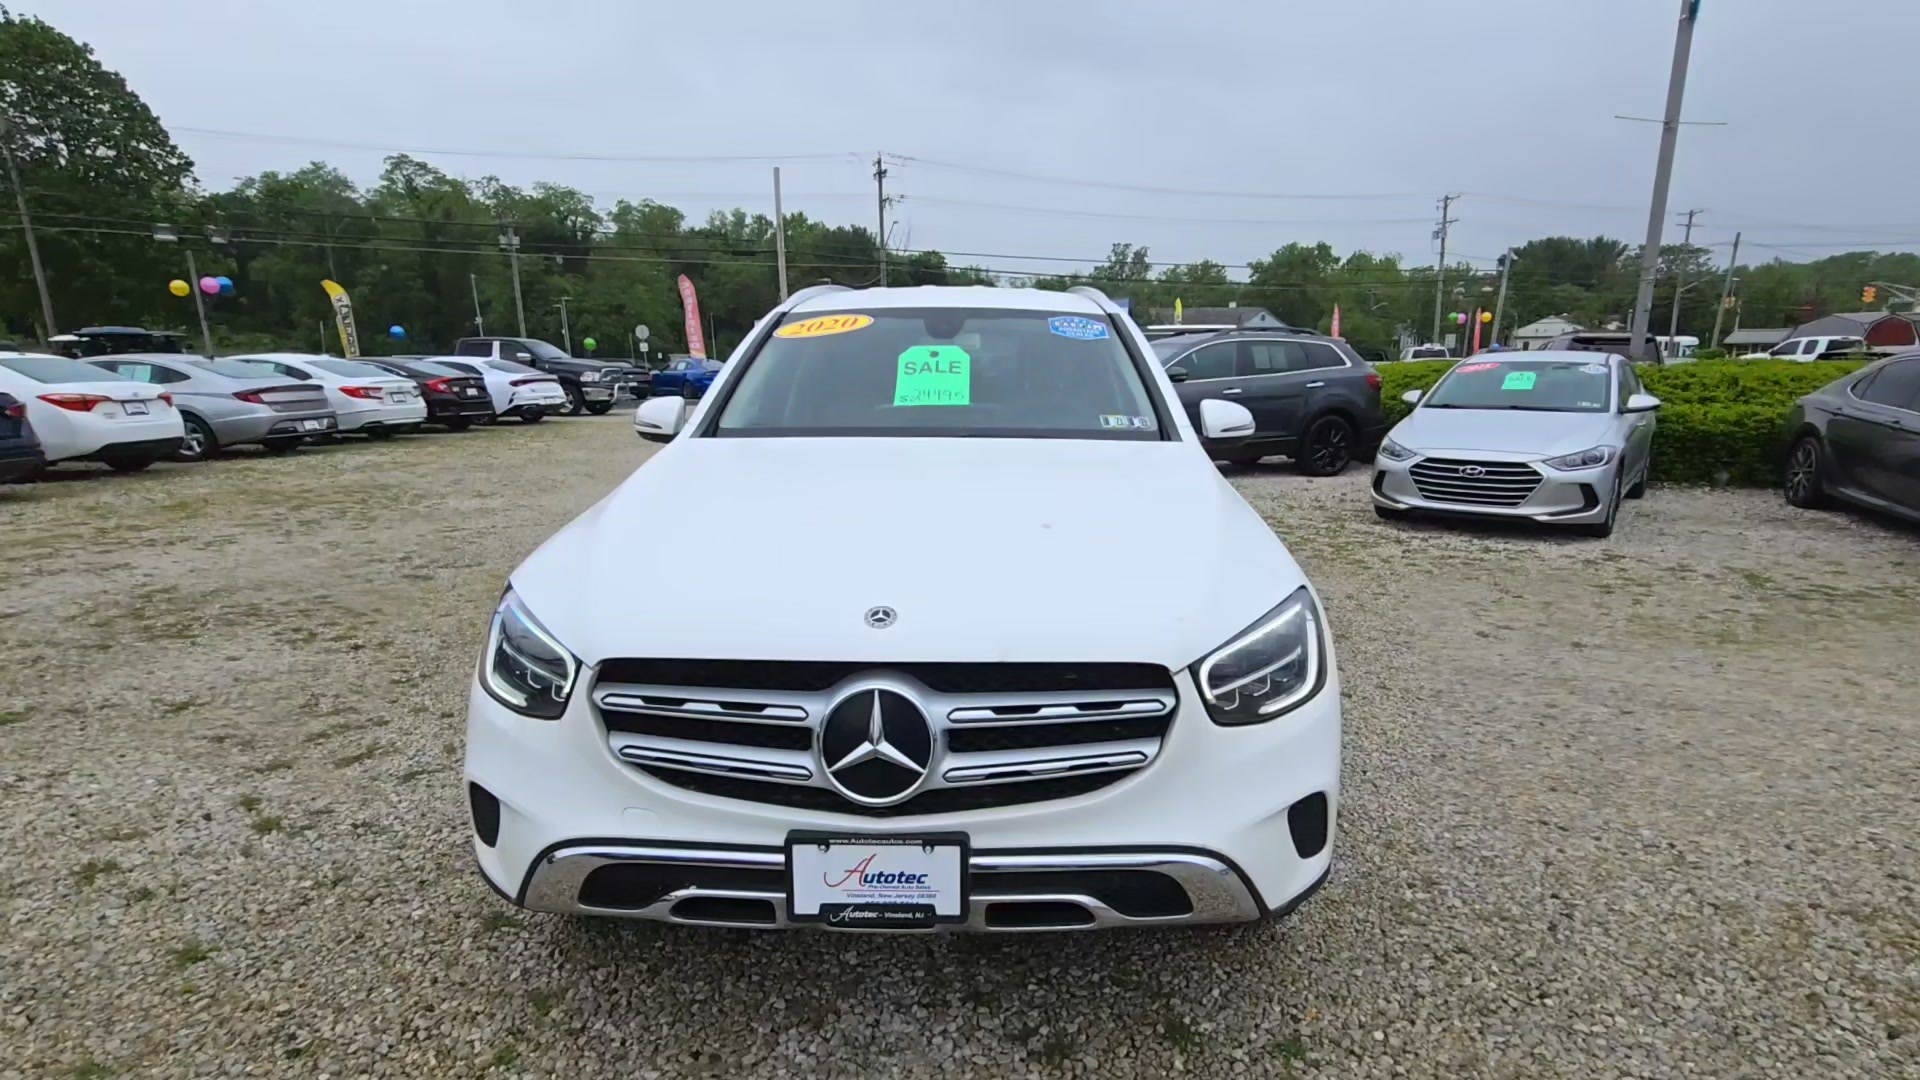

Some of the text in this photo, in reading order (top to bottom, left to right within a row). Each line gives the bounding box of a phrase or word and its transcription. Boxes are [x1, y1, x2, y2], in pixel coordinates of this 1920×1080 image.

[789, 316, 859, 335] 2020
[904, 360, 962, 375] SALE
[823, 853, 929, 888] Autotec
[829, 905, 879, 922] Autotec
